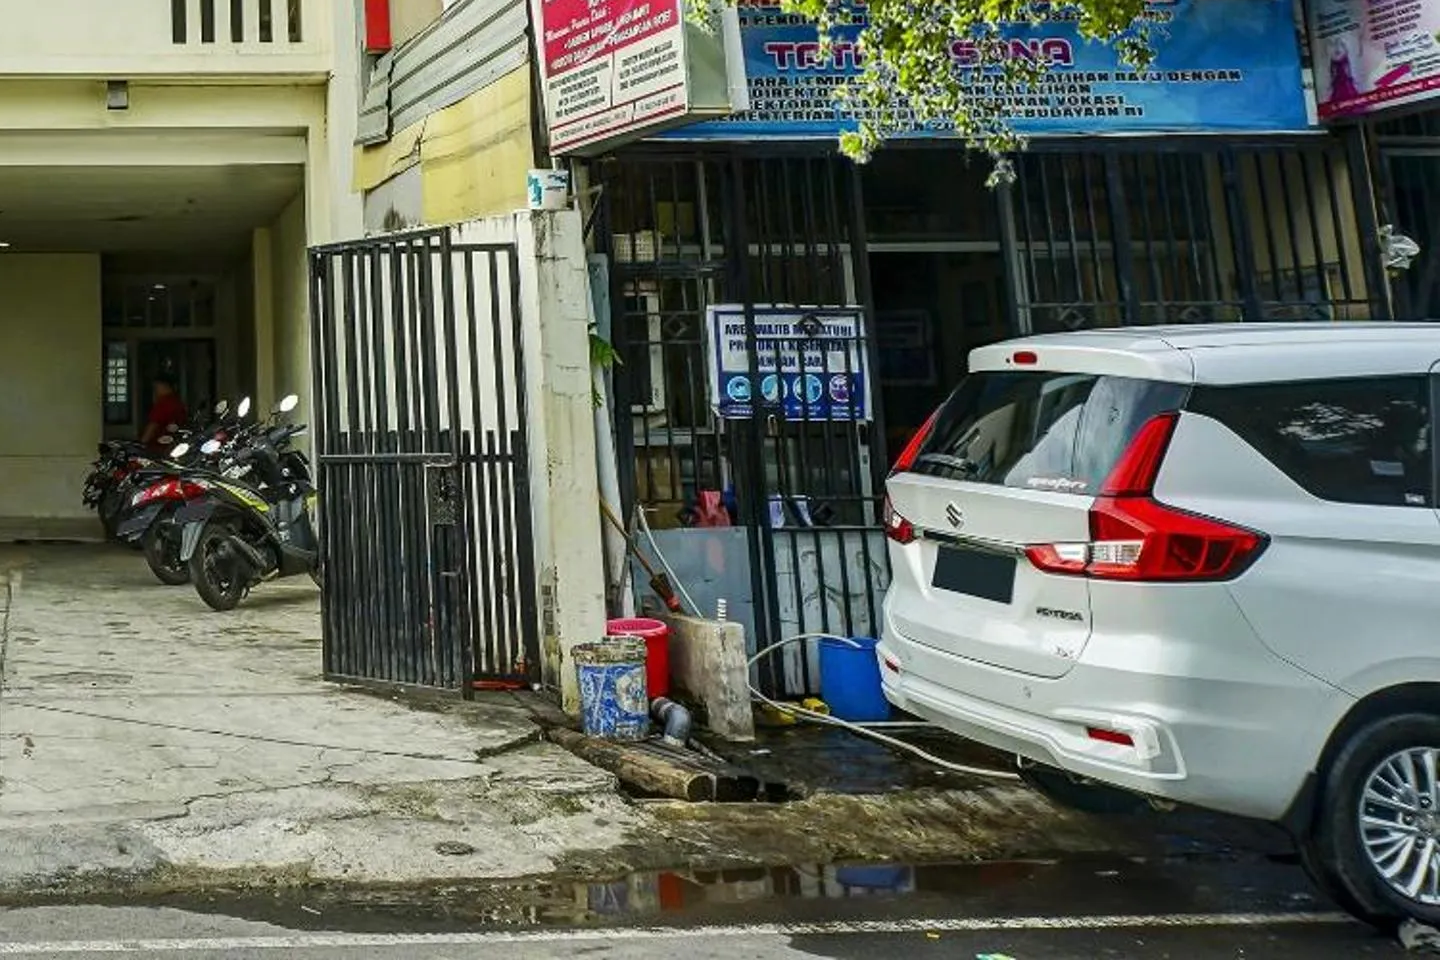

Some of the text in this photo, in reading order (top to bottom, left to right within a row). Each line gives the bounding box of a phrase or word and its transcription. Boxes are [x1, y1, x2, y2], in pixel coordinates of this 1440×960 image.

[1167, 69, 1242, 82] DENGAN
[1056, 94, 1124, 107] VOKASI
[725, 324, 747, 336] ARE
